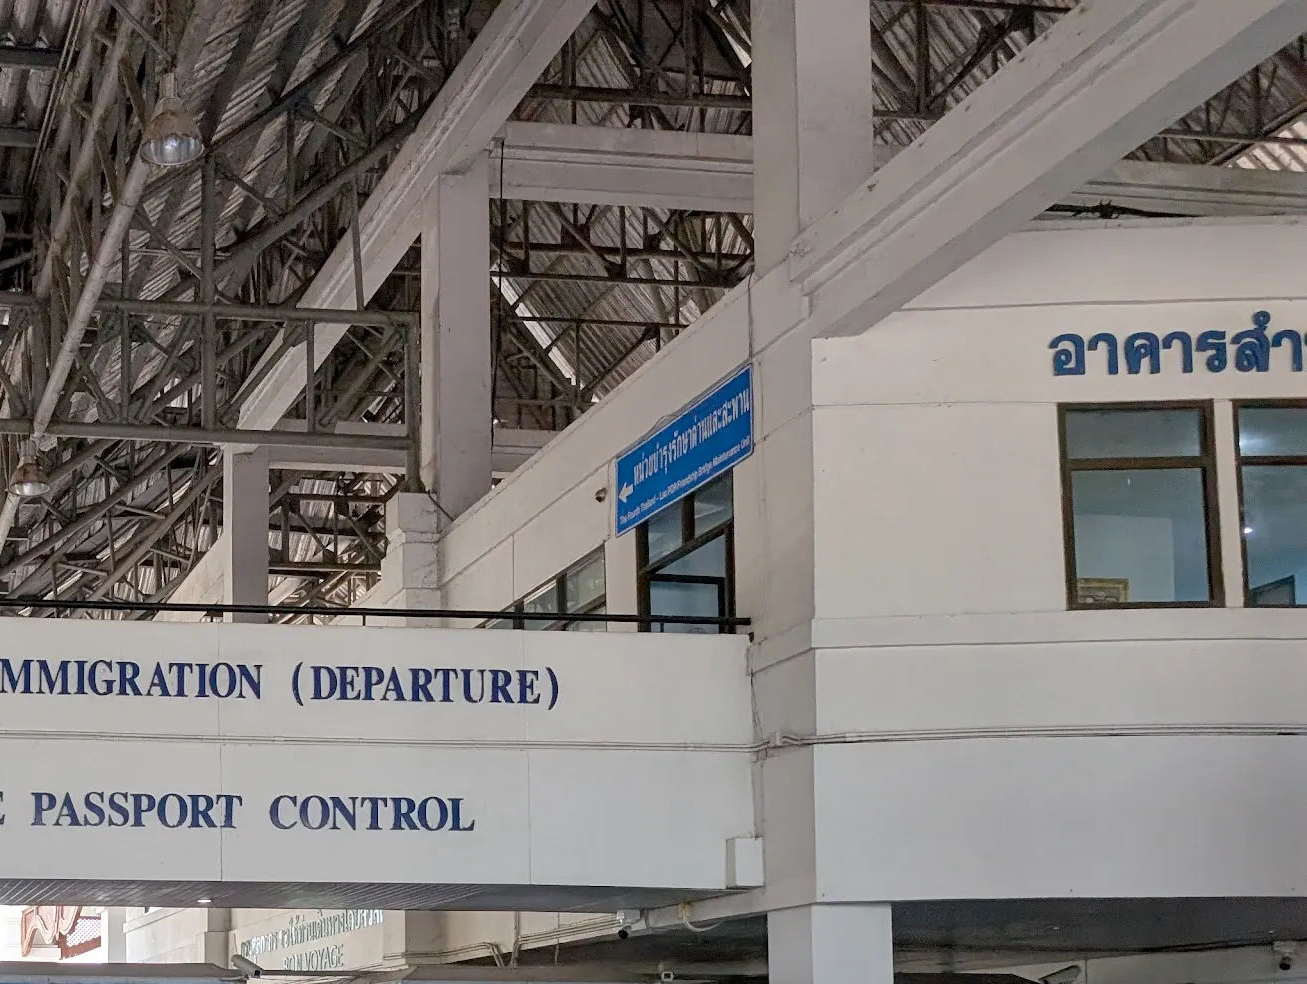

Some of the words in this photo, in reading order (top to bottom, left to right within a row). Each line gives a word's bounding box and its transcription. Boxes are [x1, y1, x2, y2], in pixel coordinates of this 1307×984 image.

[1048, 310, 1307, 376] อาคารสำ
[293, 661, 560, 711] (DEPARTURE)
[31, 789, 243, 829] PASSPORT
[269, 794, 476, 832] CONTROL
[305, 944, 345, 971] VOYAGE
